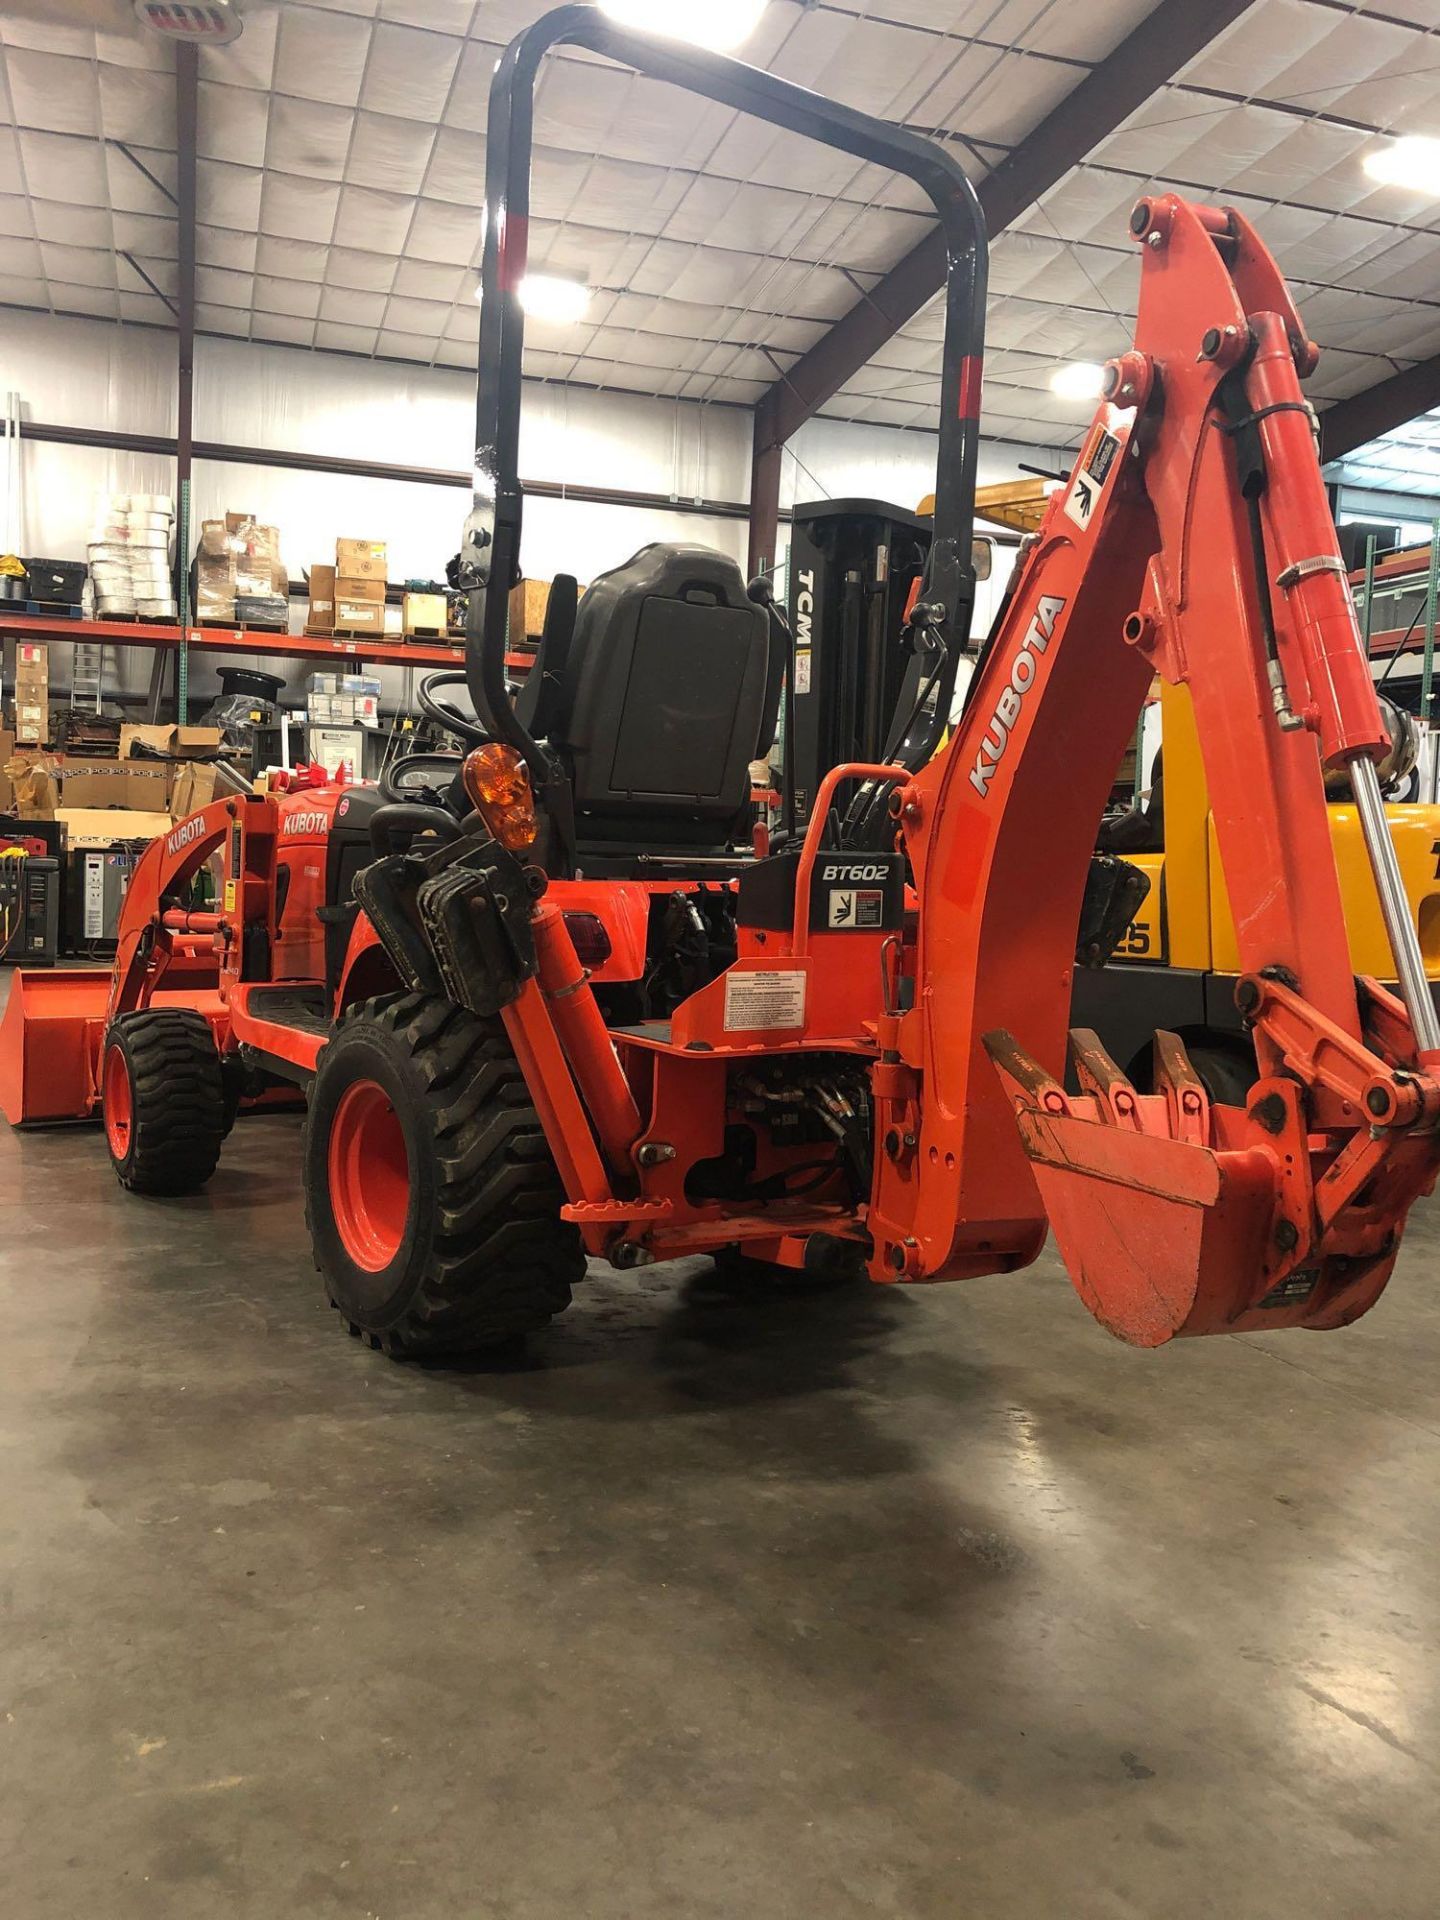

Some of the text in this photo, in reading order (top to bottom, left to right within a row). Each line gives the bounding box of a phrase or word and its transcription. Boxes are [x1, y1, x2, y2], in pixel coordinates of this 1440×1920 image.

[796, 569, 814, 645] TCM
[969, 595, 1067, 799] KUBOTA
[168, 816, 206, 856] KUBOTA
[284, 813, 329, 835] KUBOTA
[822, 865, 889, 880] BT602
